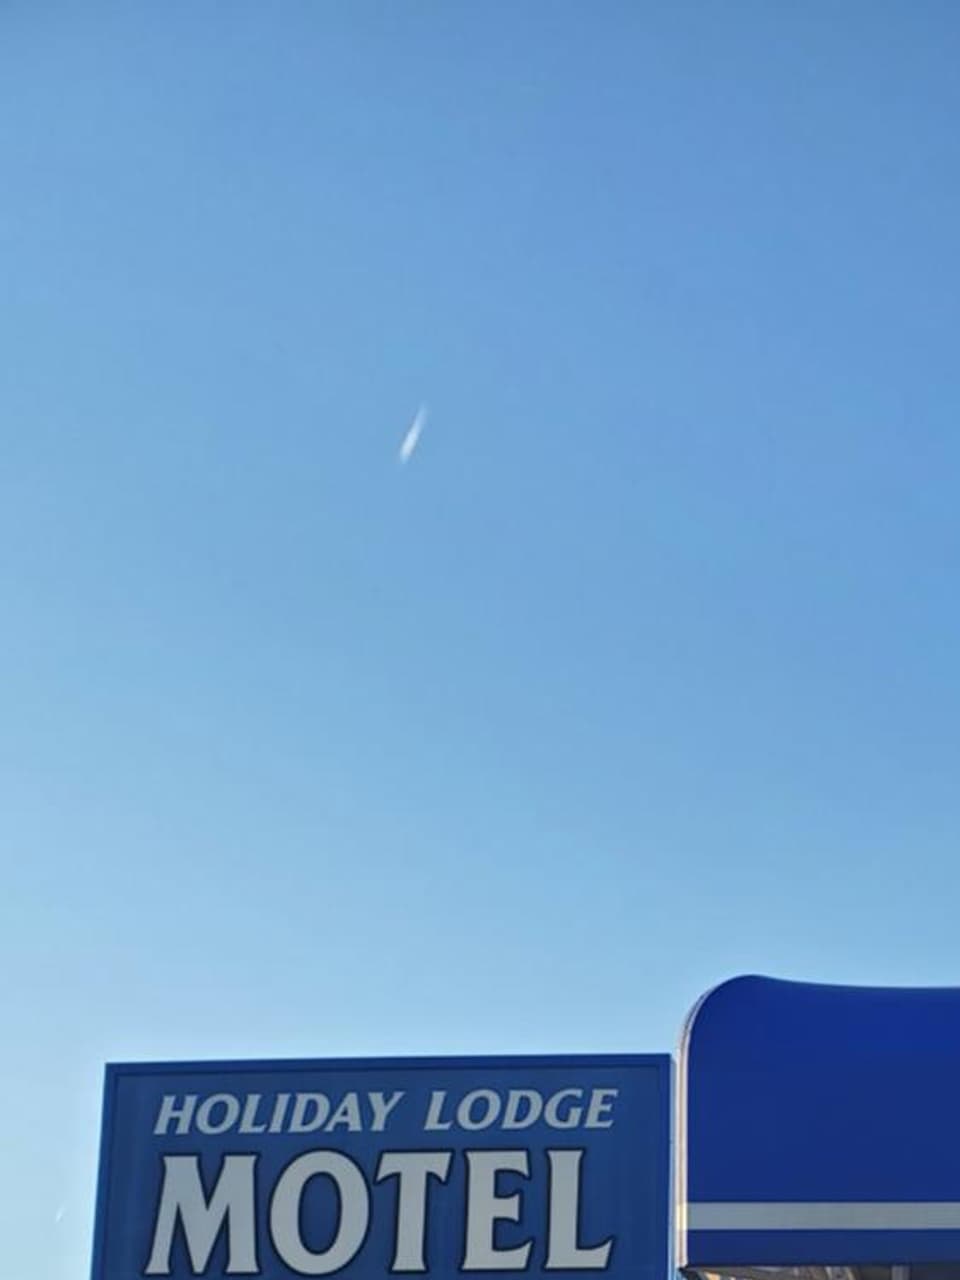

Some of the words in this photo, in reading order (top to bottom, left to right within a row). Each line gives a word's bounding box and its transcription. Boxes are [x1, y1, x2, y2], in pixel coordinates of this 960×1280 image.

[153, 1092, 403, 1135] HOLIDAY
[424, 1089, 618, 1131] LODGE
[143, 1149, 616, 1276] MOTEL
